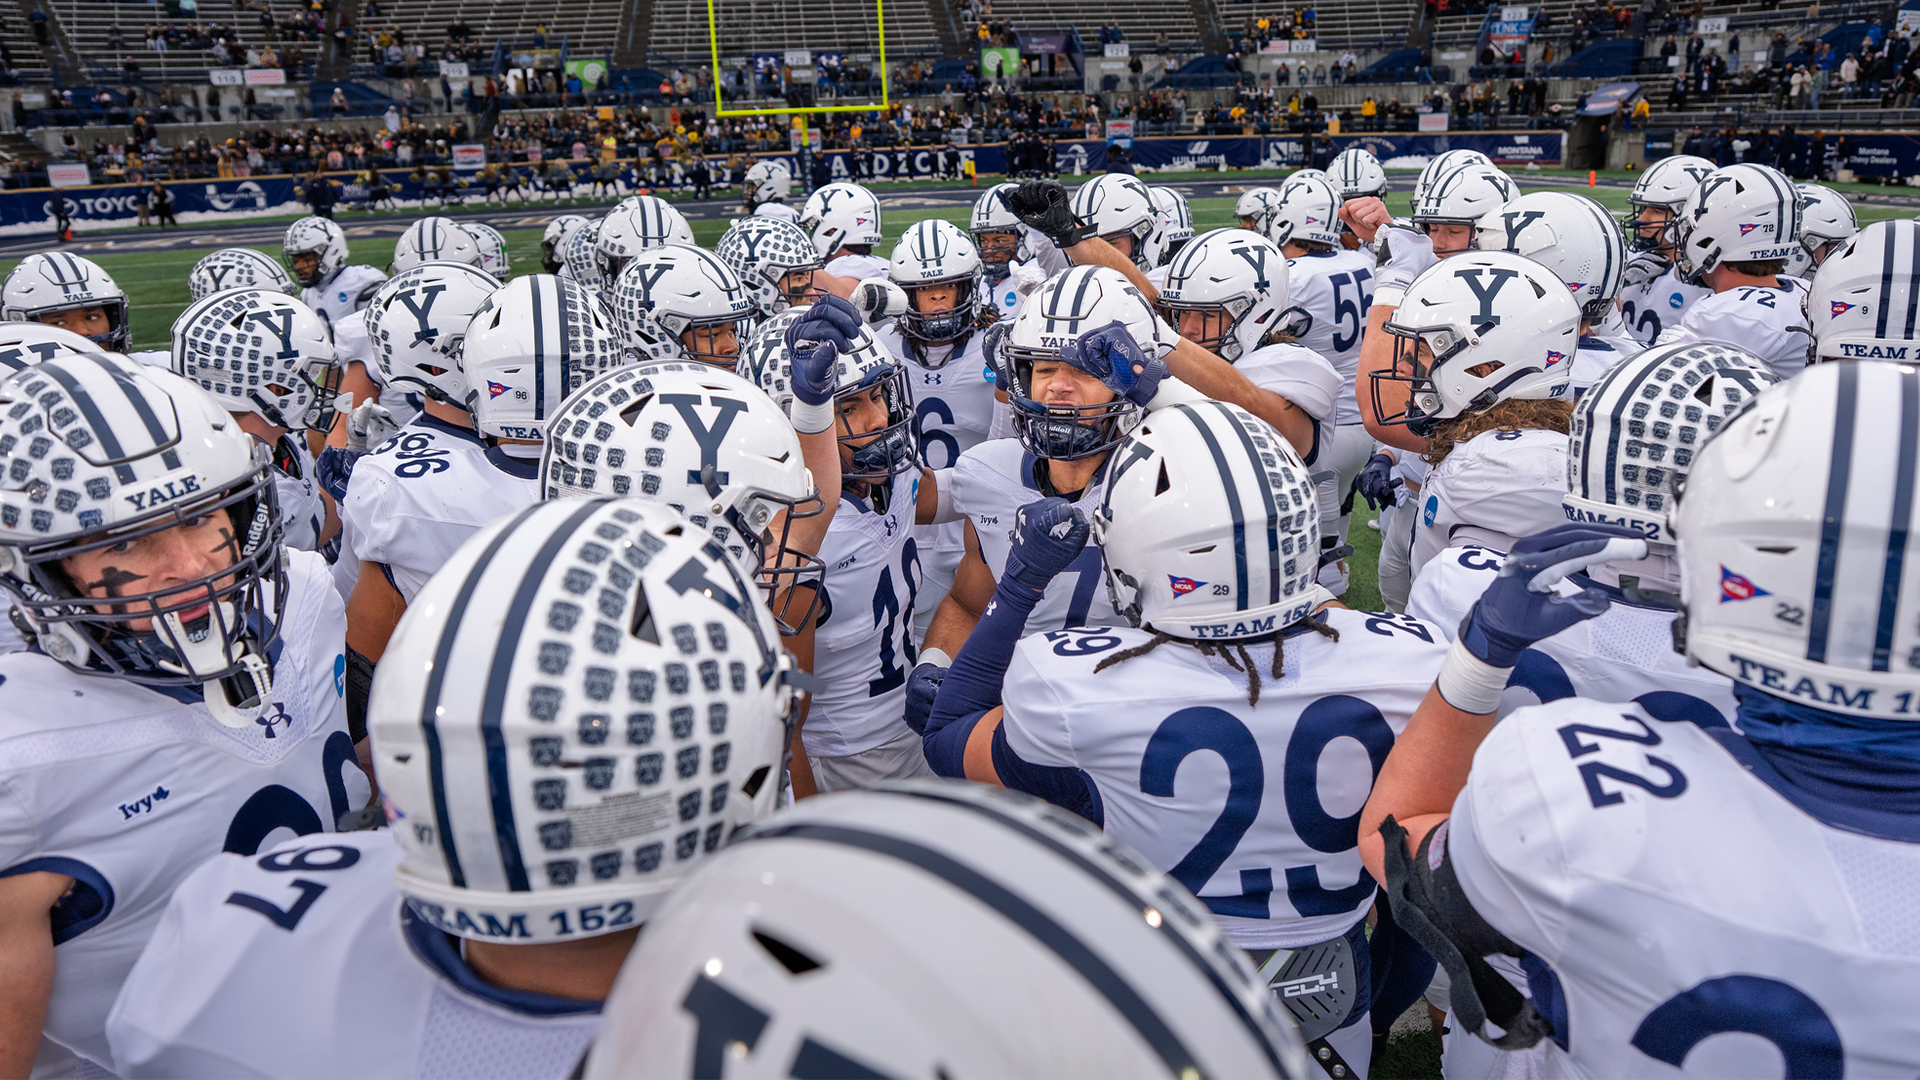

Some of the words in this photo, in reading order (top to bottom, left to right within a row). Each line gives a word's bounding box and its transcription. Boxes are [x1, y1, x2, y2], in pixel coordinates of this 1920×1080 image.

[1507, 11, 1523, 19] 123
[1703, 23, 1722, 31] 124
[1172, 154, 1223, 165] WILLIAMS
[1497, 146, 1544, 155] MONTANA
[1858, 147, 1890, 155] Montana
[80, 195, 140, 214] TOYO
[818, 188, 842, 217] Y
[1122, 181, 1158, 212] Y
[1253, 192, 1270, 208] Y
[1694, 177, 1733, 221] Y
[310, 221, 334, 242] Y
[1167, 230, 1189, 241] TEAM
[1309, 232, 1334, 242] TEAM
[1501, 211, 1545, 252] Y
[1763, 224, 1774, 232] 72
[738, 229, 772, 263] Y
[1751, 249, 1789, 260] TEAM
[205, 265, 235, 293] Y
[921, 269, 944, 278] YALE
[1231, 245, 1270, 293] Y
[64, 291, 94, 302] YALE
[635, 264, 675, 313] Y
[1162, 290, 1181, 300] YALE
[1454, 268, 1519, 325] Y
[1588, 285, 1600, 295] 58
[1738, 288, 1776, 309] 72
[395, 284, 446, 340] Y
[730, 300, 749, 312] YALE
[1327, 268, 1374, 353] 55
[1861, 305, 1869, 314] 9
[248, 308, 300, 359] Y
[1040, 336, 1077, 348] YALE
[1113, 339, 1130, 359] UA
[1840, 343, 1907, 360] TEAM
[490, 386, 503, 394] NCAA
[515, 390, 528, 400] 96
[1549, 384, 1571, 398] TEA
[500, 426, 544, 440] TEA
[659, 394, 750, 486] Y
[911, 396, 961, 472] 6
[125, 474, 201, 512] YALE
[241, 502, 270, 556] Riddell
[979, 514, 993, 526] Ivy
[1562, 503, 1608, 524] TEAM
[1617, 516, 1661, 540] 152
[837, 557, 849, 570] Ivy
[1174, 582, 1193, 591] NCAA
[1213, 585, 1230, 596] 29
[1723, 580, 1748, 597] NCAA
[1190, 615, 1275, 639] TEAM
[1282, 601, 1312, 623] 152
[1775, 603, 1805, 627] 22
[1729, 653, 1877, 714] TEAM
[1557, 713, 1689, 809] 22
[118, 792, 153, 821] Ivy
[1140, 694, 1396, 920] 29
[413, 822, 434, 846] 97
[225, 845, 361, 932] 97
[406, 897, 533, 941] TEAM
[549, 900, 636, 937] 152
